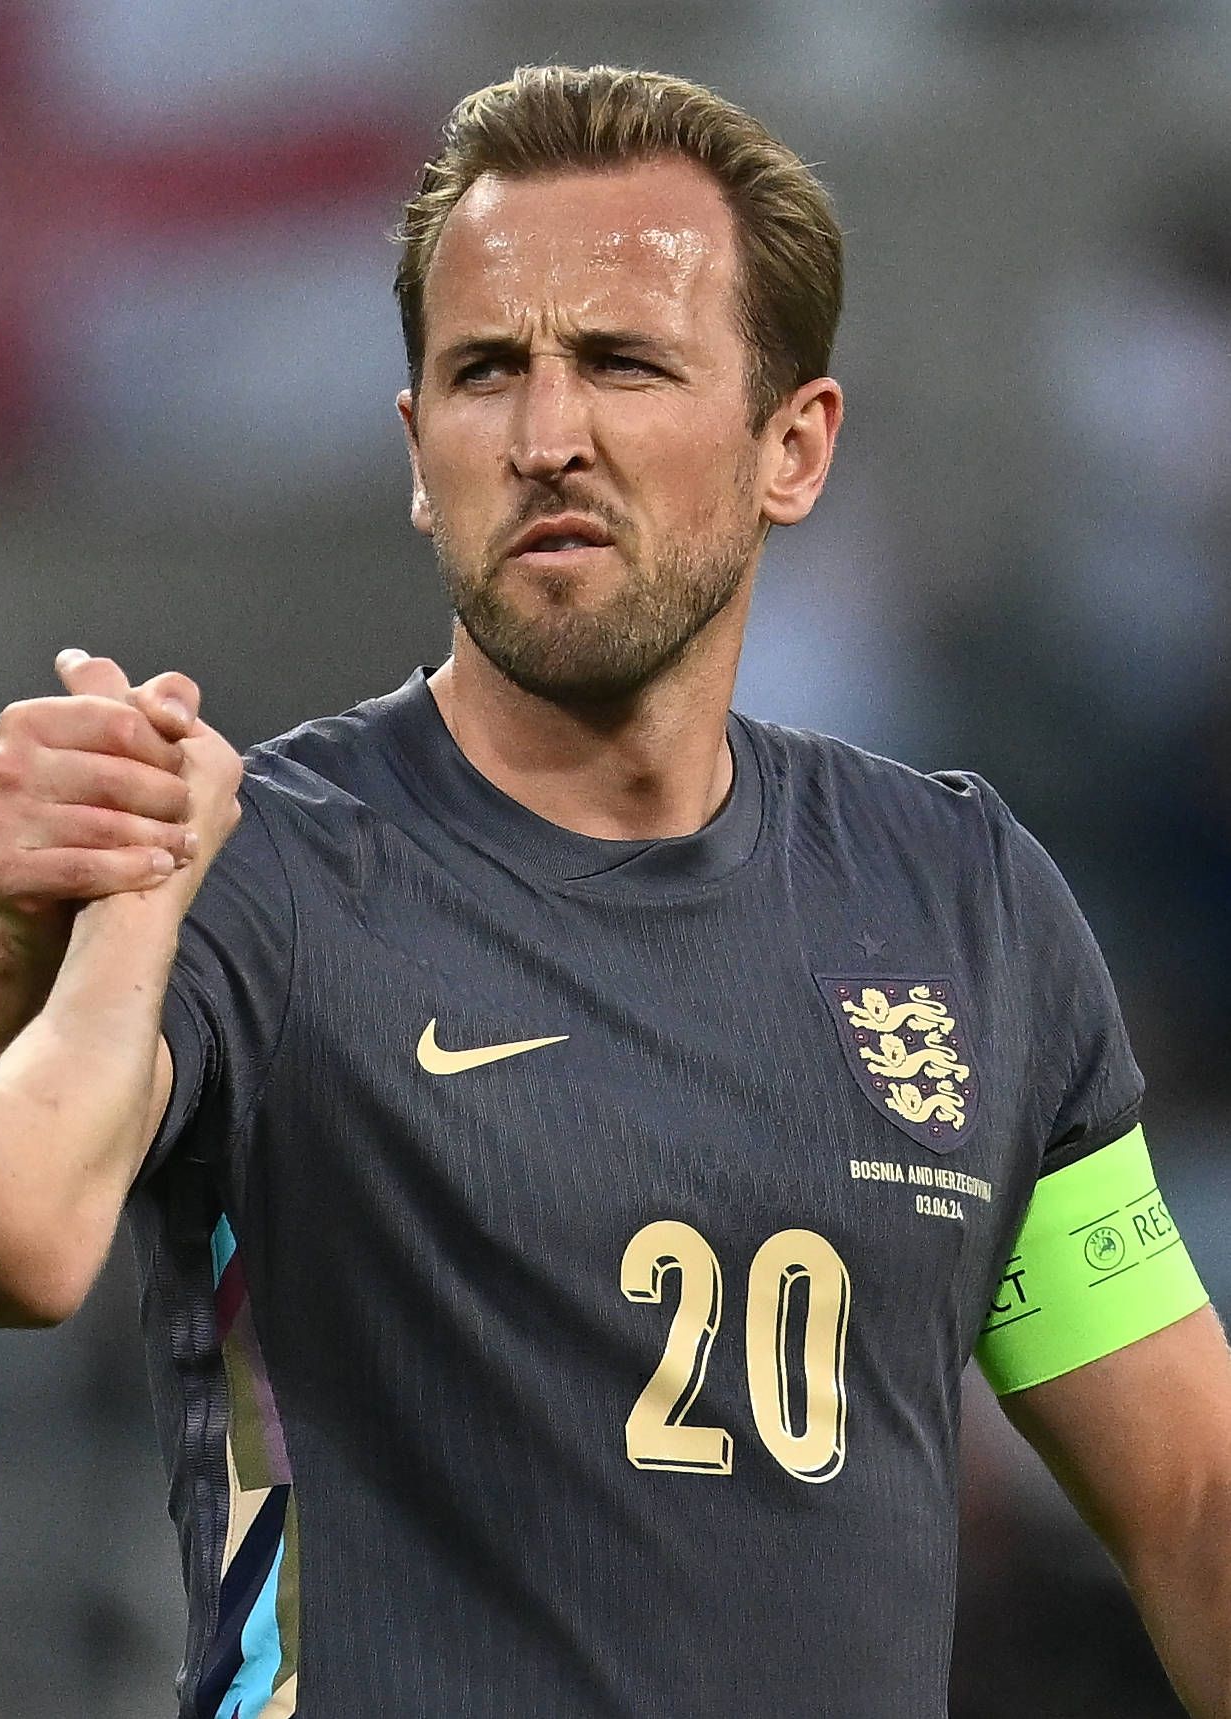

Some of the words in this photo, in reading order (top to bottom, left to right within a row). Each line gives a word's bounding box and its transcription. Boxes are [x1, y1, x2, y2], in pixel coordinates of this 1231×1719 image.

[850, 1160, 904, 1183] BOSNIA
[908, 1165, 933, 1186] AND
[915, 1194, 964, 1221] 03.06.24
[621, 1220, 851, 1483] 20
